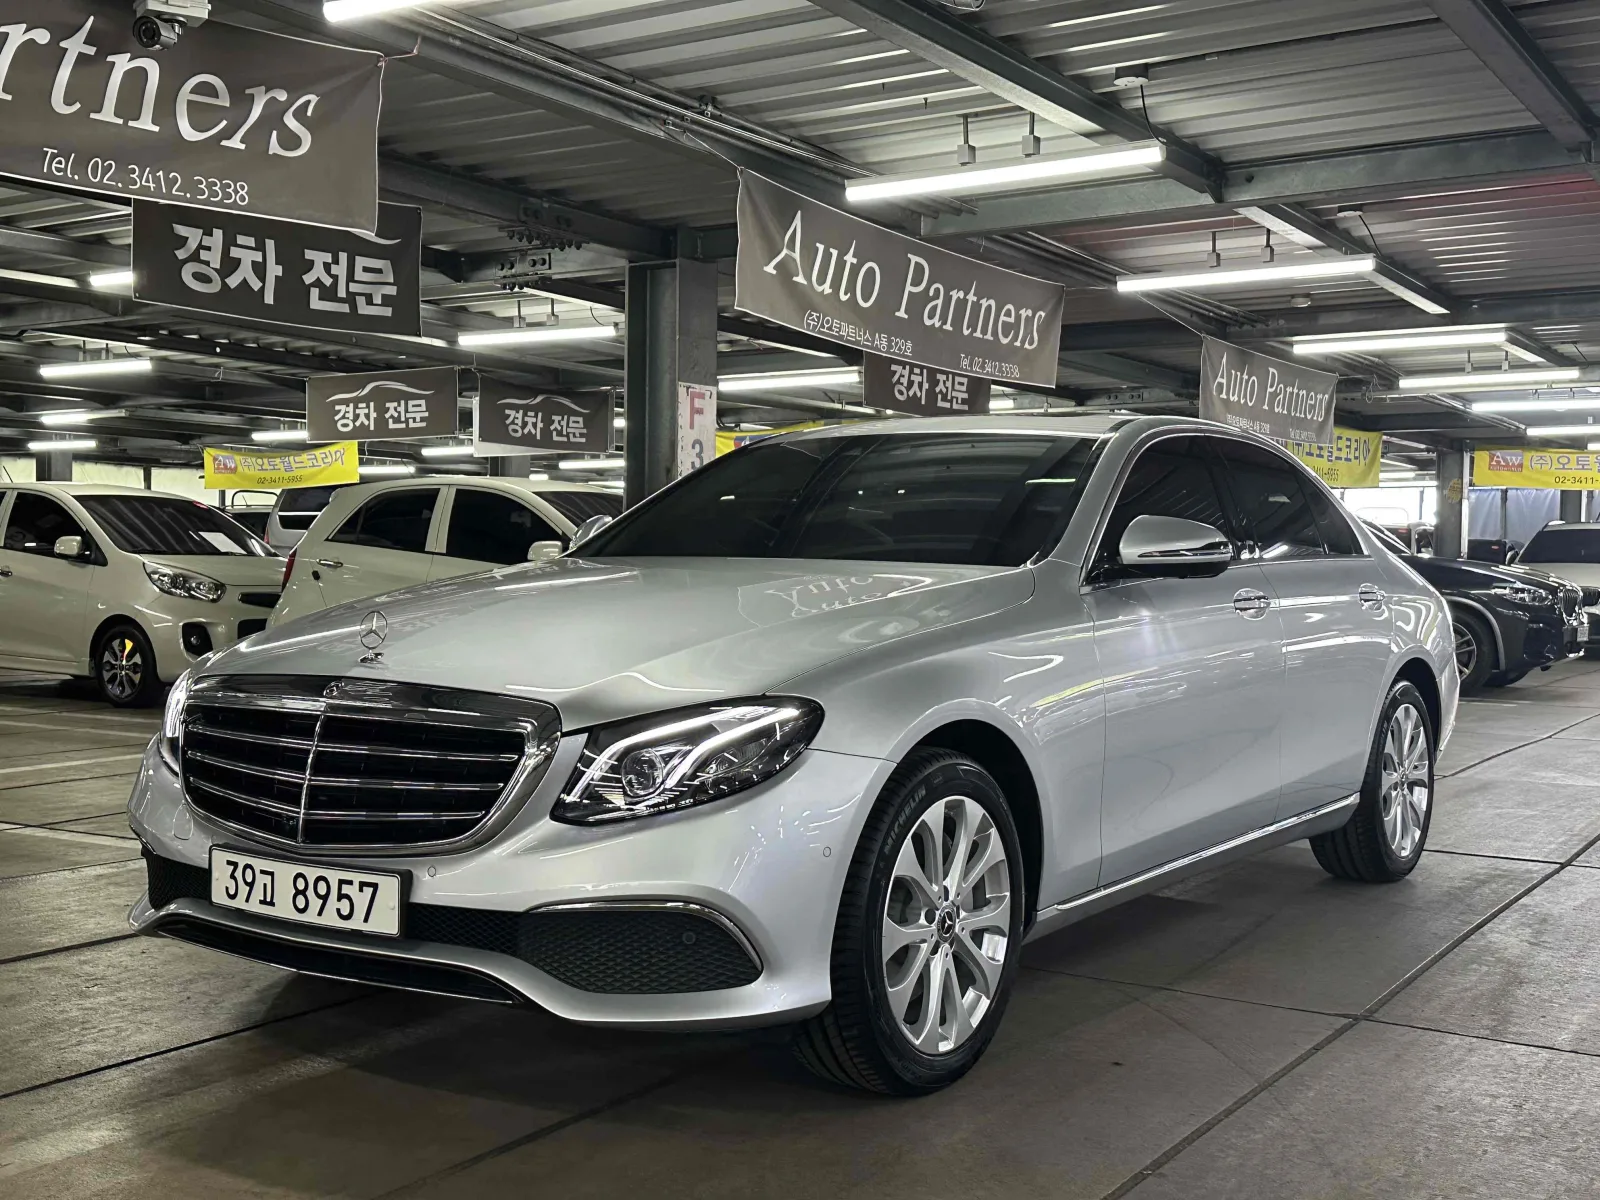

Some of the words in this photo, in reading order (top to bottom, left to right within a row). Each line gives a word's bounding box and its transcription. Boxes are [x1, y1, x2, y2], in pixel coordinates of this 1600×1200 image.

[42, 147, 79, 180] Tel.
[87, 158, 249, 206] 02.3412.3338
[172, 223, 283, 305] 경차
[302, 248, 398, 317] 전문
[763, 209, 881, 308] Auto
[895, 253, 1046, 350] Partners
[803, 309, 872, 346] (주)오토파트너스
[873, 331, 888, 351] A동
[890, 337, 913, 357] 329호
[890, 363, 929, 405] 경차
[934, 372, 969, 411] 전문
[972, 359, 1020, 378] 02.3412.3338
[1213, 351, 1258, 407] Auto
[1263, 366, 1329, 422] Partners
[334, 402, 377, 432] 경차
[384, 399, 429, 429] 전문
[504, 409, 544, 440] 경차
[550, 414, 587, 443] 전문
[689, 390, 706, 430] F
[240, 447, 346, 472] (주)오토월드코리아
[690, 438, 704, 470] 3
[1529, 454, 1600, 473] (주)오토
[257, 475, 303, 484] 02-3411-5955
[1554, 475, 1600, 485] 02-3411-
[225, 859, 276, 908] 39고
[292, 871, 379, 923] 8957
